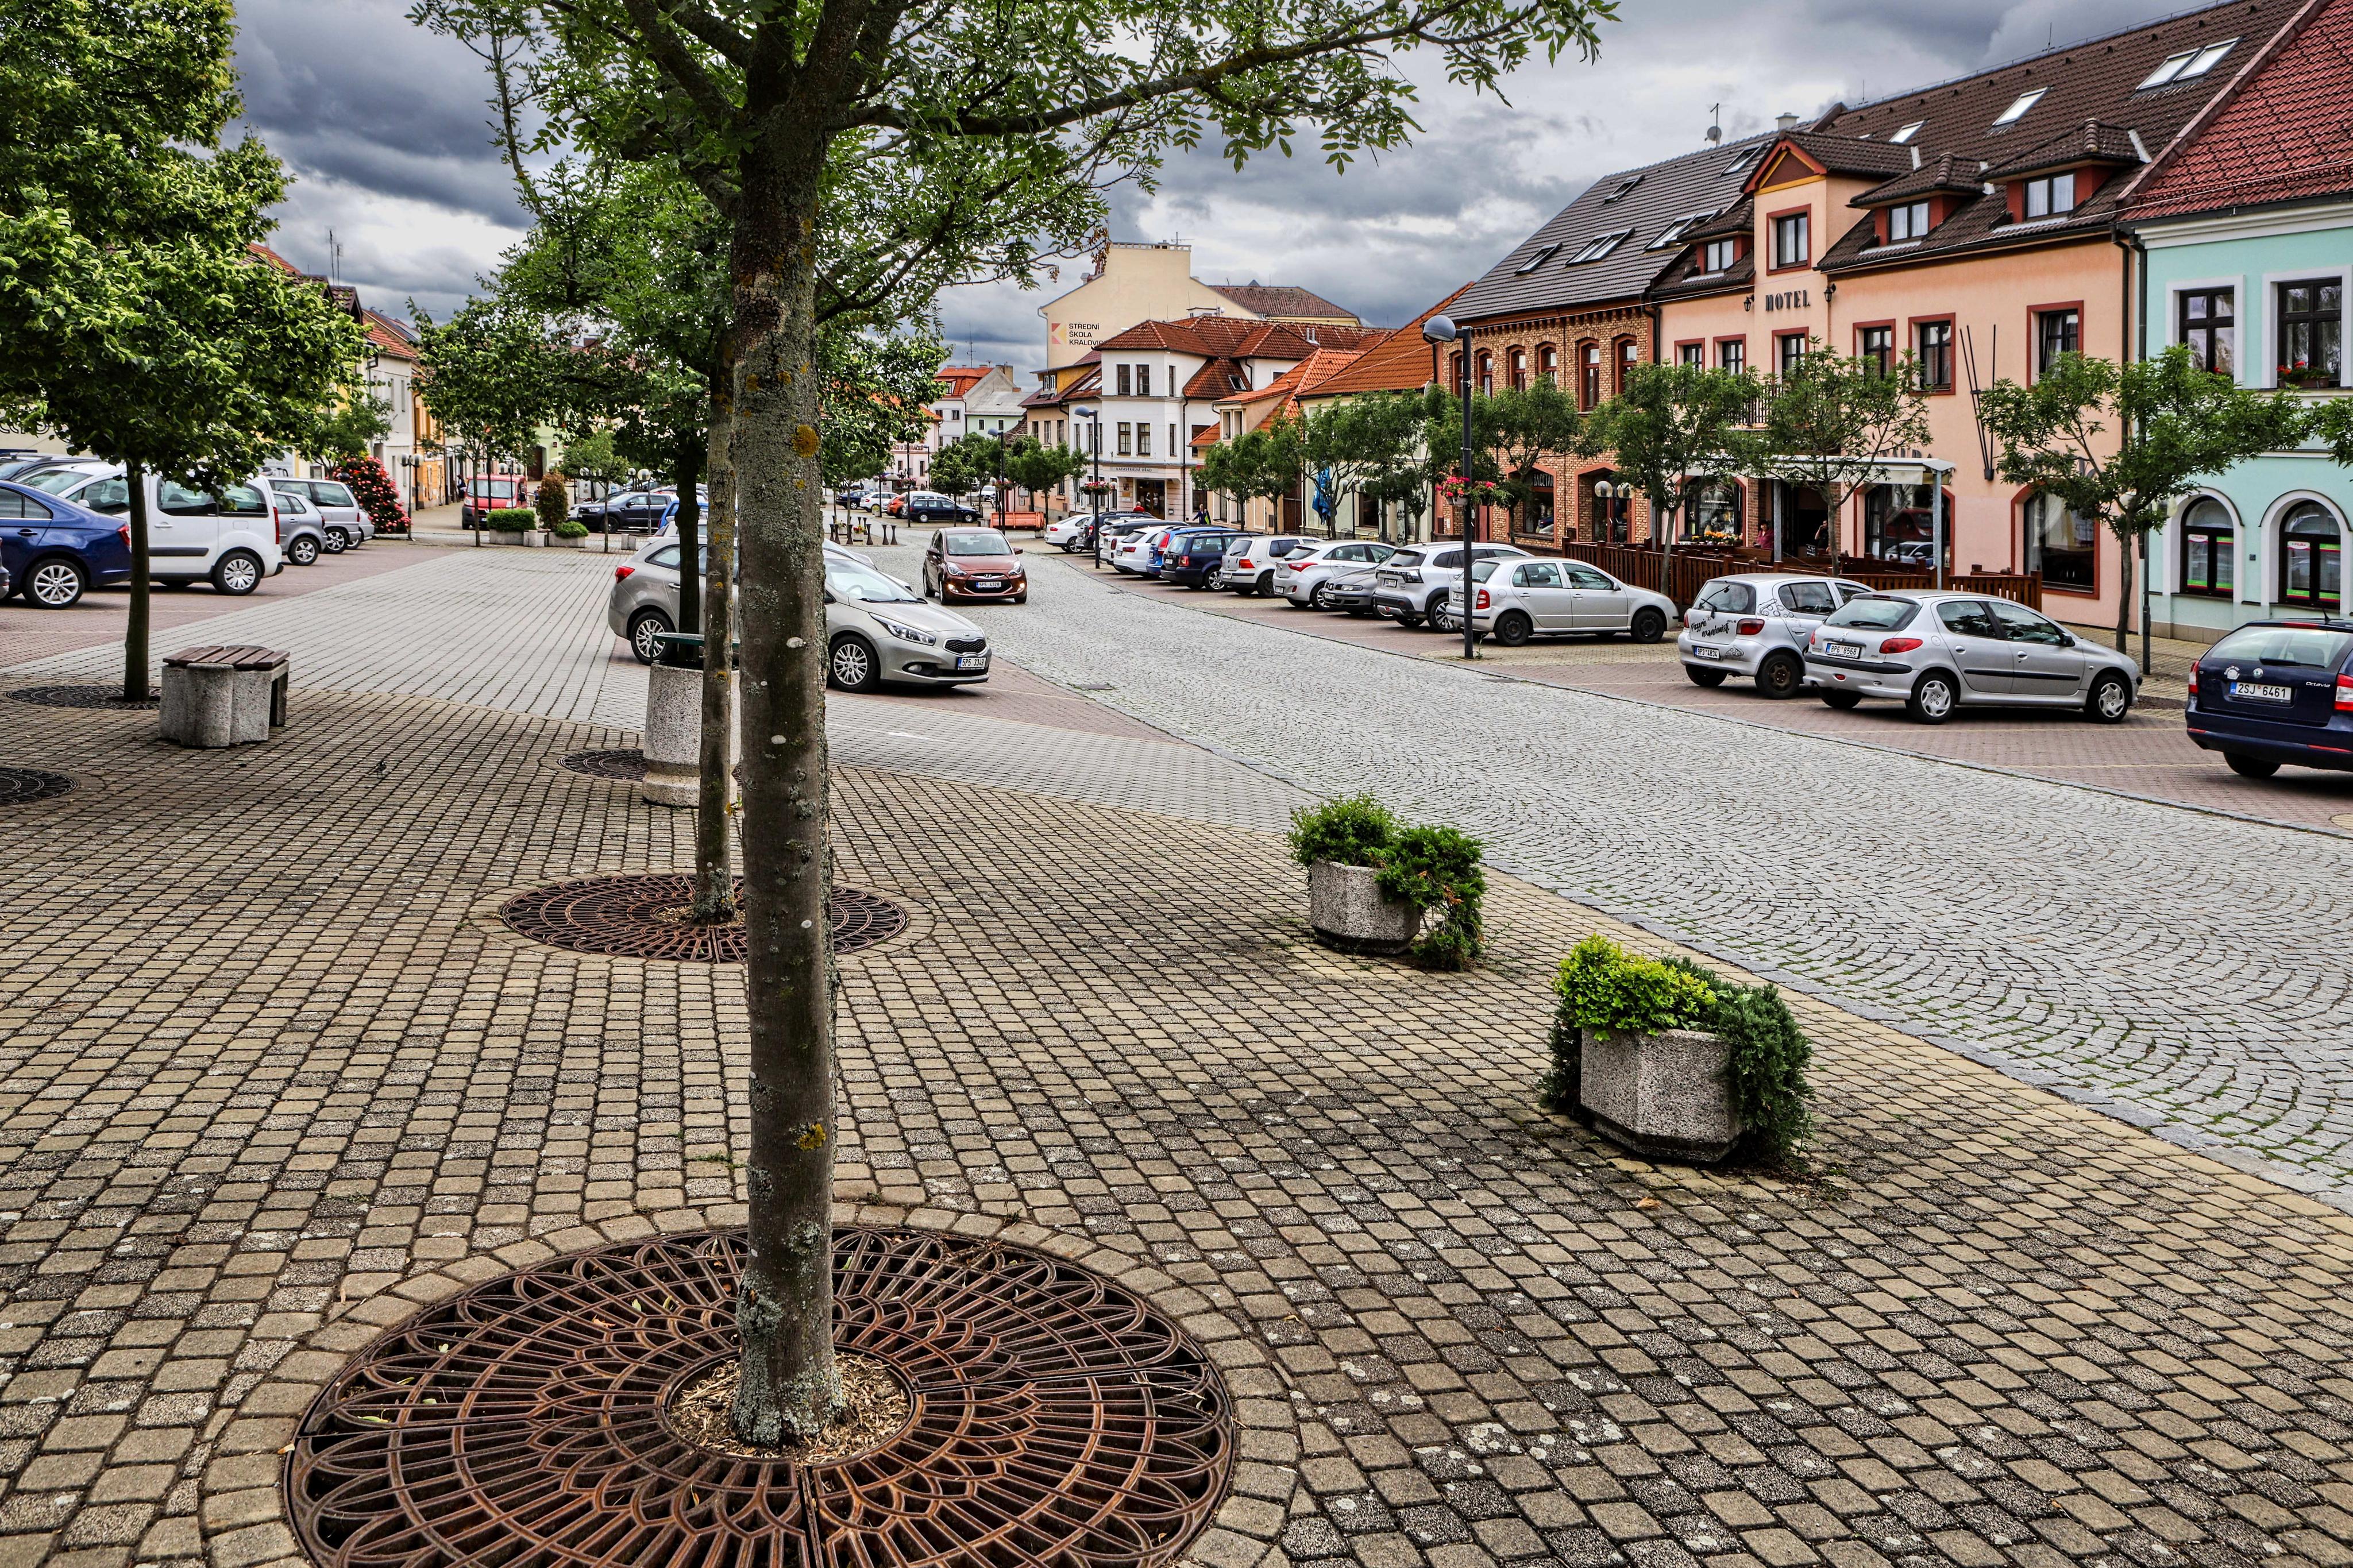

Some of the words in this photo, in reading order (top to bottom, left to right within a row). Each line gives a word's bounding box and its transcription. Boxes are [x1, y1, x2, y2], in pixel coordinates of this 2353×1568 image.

[1765, 290, 1811, 311] HOTEL
[1830, 645, 1840, 653] 8P6
[1843, 646, 1857, 655] 8568
[2238, 683, 2256, 694] 2SJ
[2262, 686, 2286, 698] 6461
